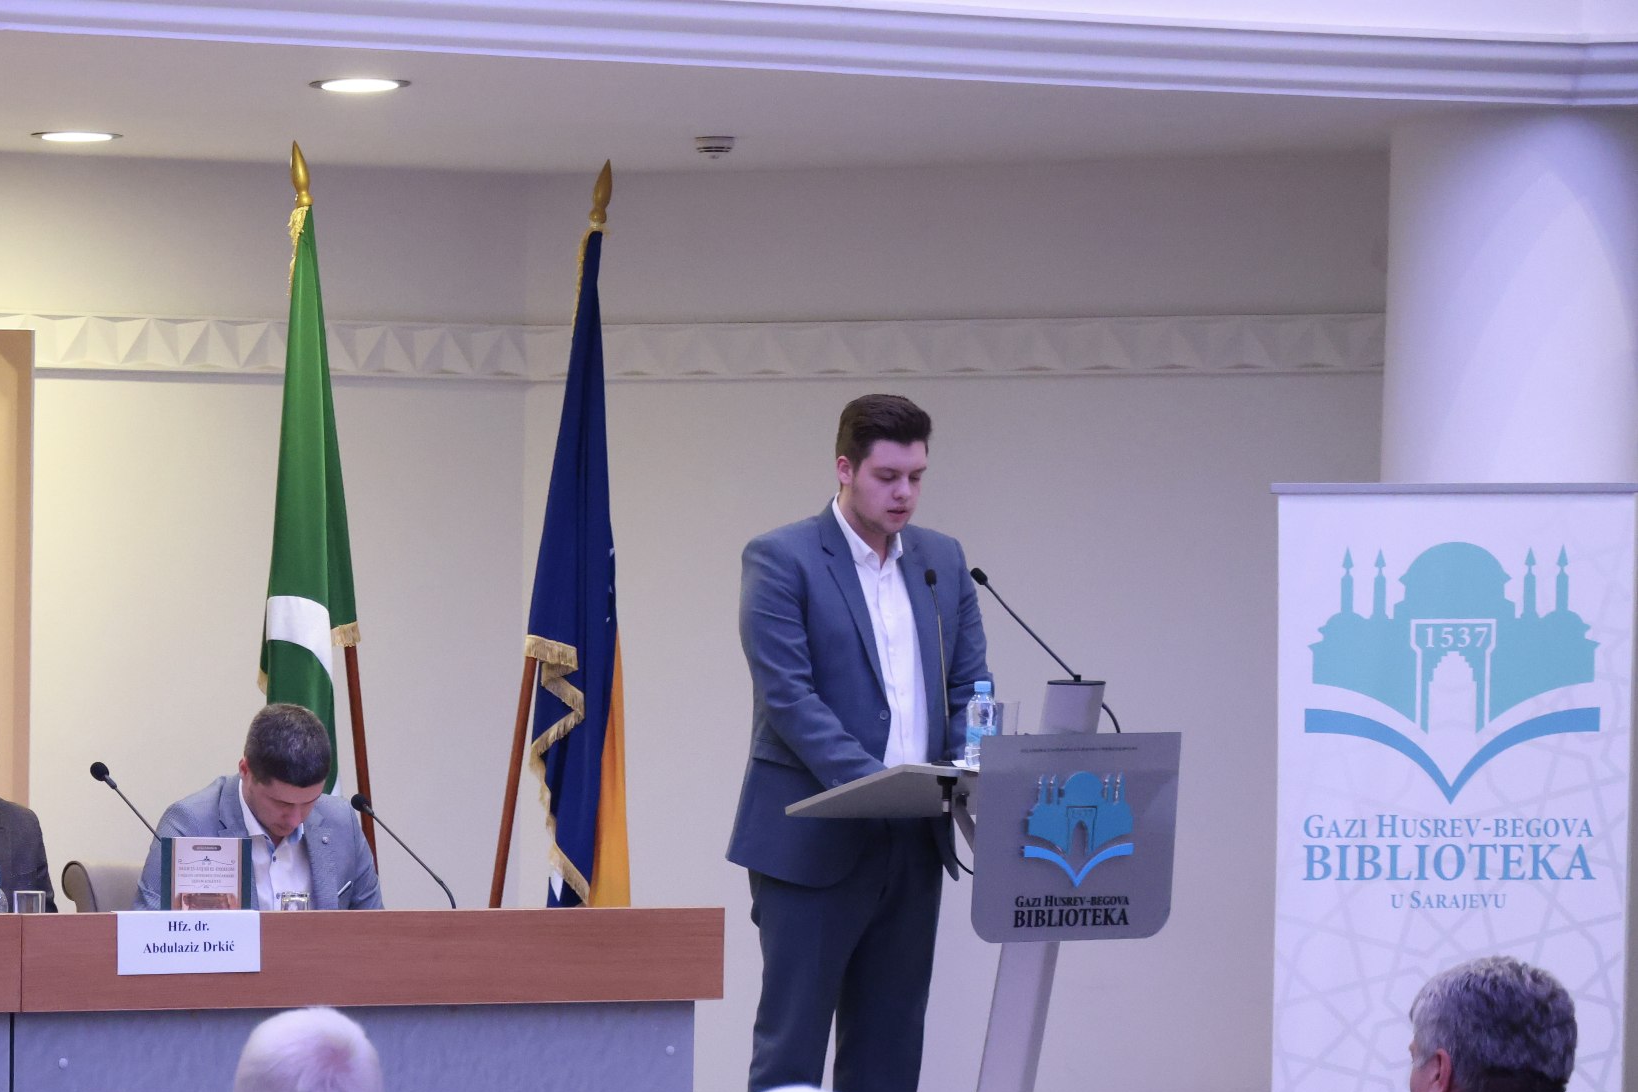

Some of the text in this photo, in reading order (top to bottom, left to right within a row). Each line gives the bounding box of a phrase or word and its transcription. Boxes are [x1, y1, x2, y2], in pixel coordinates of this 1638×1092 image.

[1425, 627, 1488, 648] 1537
[1303, 814, 1595, 839] GAZI HUSREV-BEGOVA
[1302, 843, 1597, 881] BIBLIOTEKA
[1015, 895, 1042, 908] GAZI
[1409, 890, 1507, 910] SARAJEVU
[168, 920, 210, 932] Hfz. dr.
[1013, 908, 1130, 928] BIBLIOTEKA
[142, 940, 235, 954] Abdulaziz Drkić
